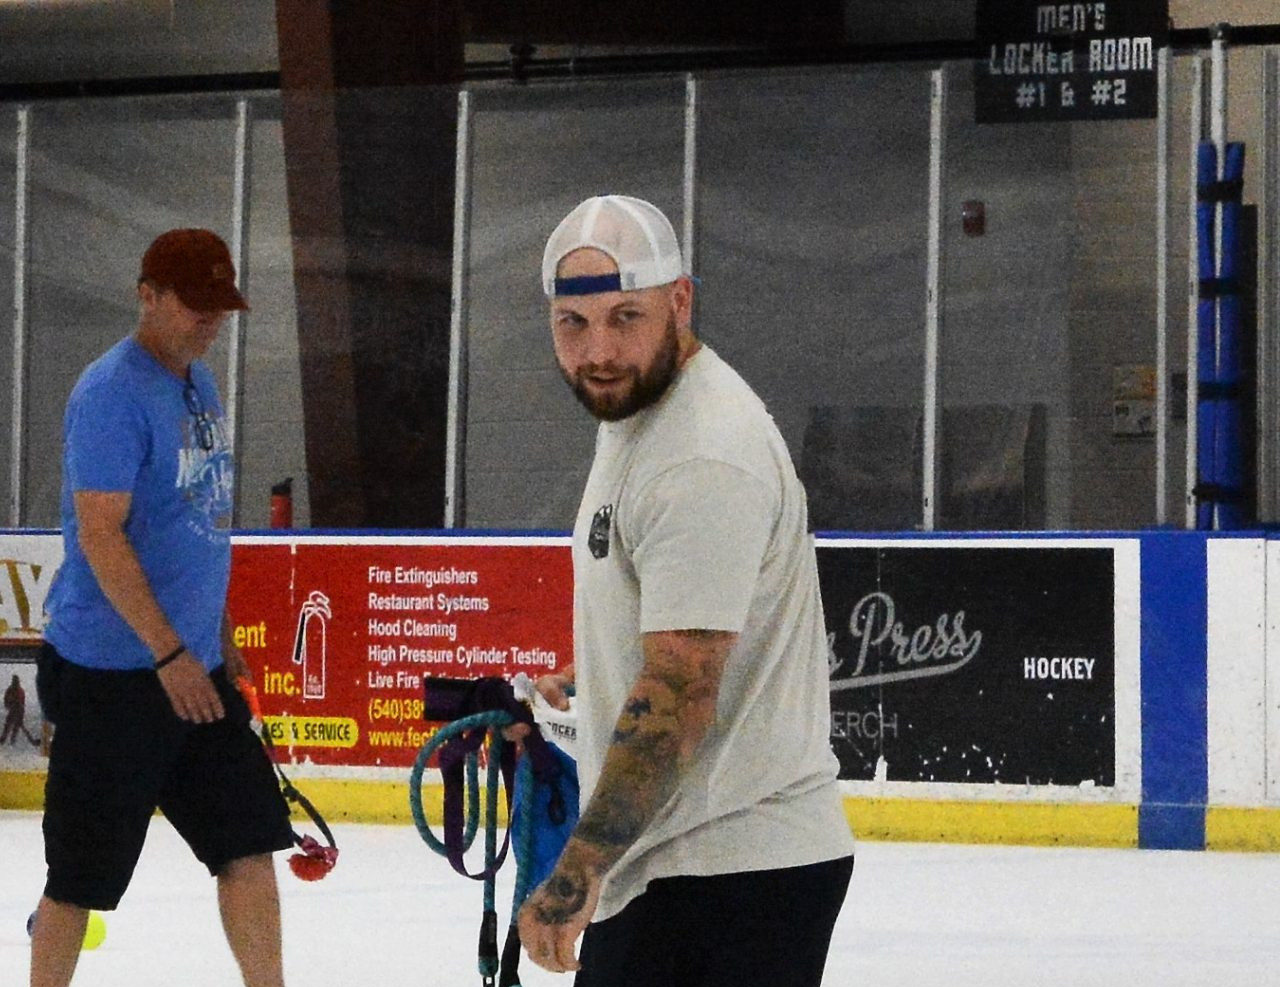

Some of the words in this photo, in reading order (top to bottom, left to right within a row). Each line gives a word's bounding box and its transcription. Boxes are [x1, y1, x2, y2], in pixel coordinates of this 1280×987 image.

[1036, 2, 1106, 33] MEN'S
[989, 41, 1074, 75] LOCKER
[1088, 36, 1153, 72] ROOM
[1016, 81, 1047, 108] #1
[1090, 78, 1127, 105] #2
[367, 566, 392, 584] Fire
[394, 567, 479, 588] Extinguishers
[367, 592, 434, 612] Restaurant
[436, 593, 490, 615] Systems
[367, 618, 401, 637] Hood
[402, 619, 458, 642] Cleaning
[849, 591, 982, 677] Press
[367, 645, 397, 666] High
[398, 645, 454, 664] Pressure
[455, 645, 508, 669] Cylinder
[509, 646, 557, 670] Testing
[1023, 657, 1095, 680] HOCKEY
[263, 665, 301, 696] inc.
[367, 671, 395, 689] Live
[396, 671, 420, 689] Fire
[304, 722, 351, 741] SERVICE
